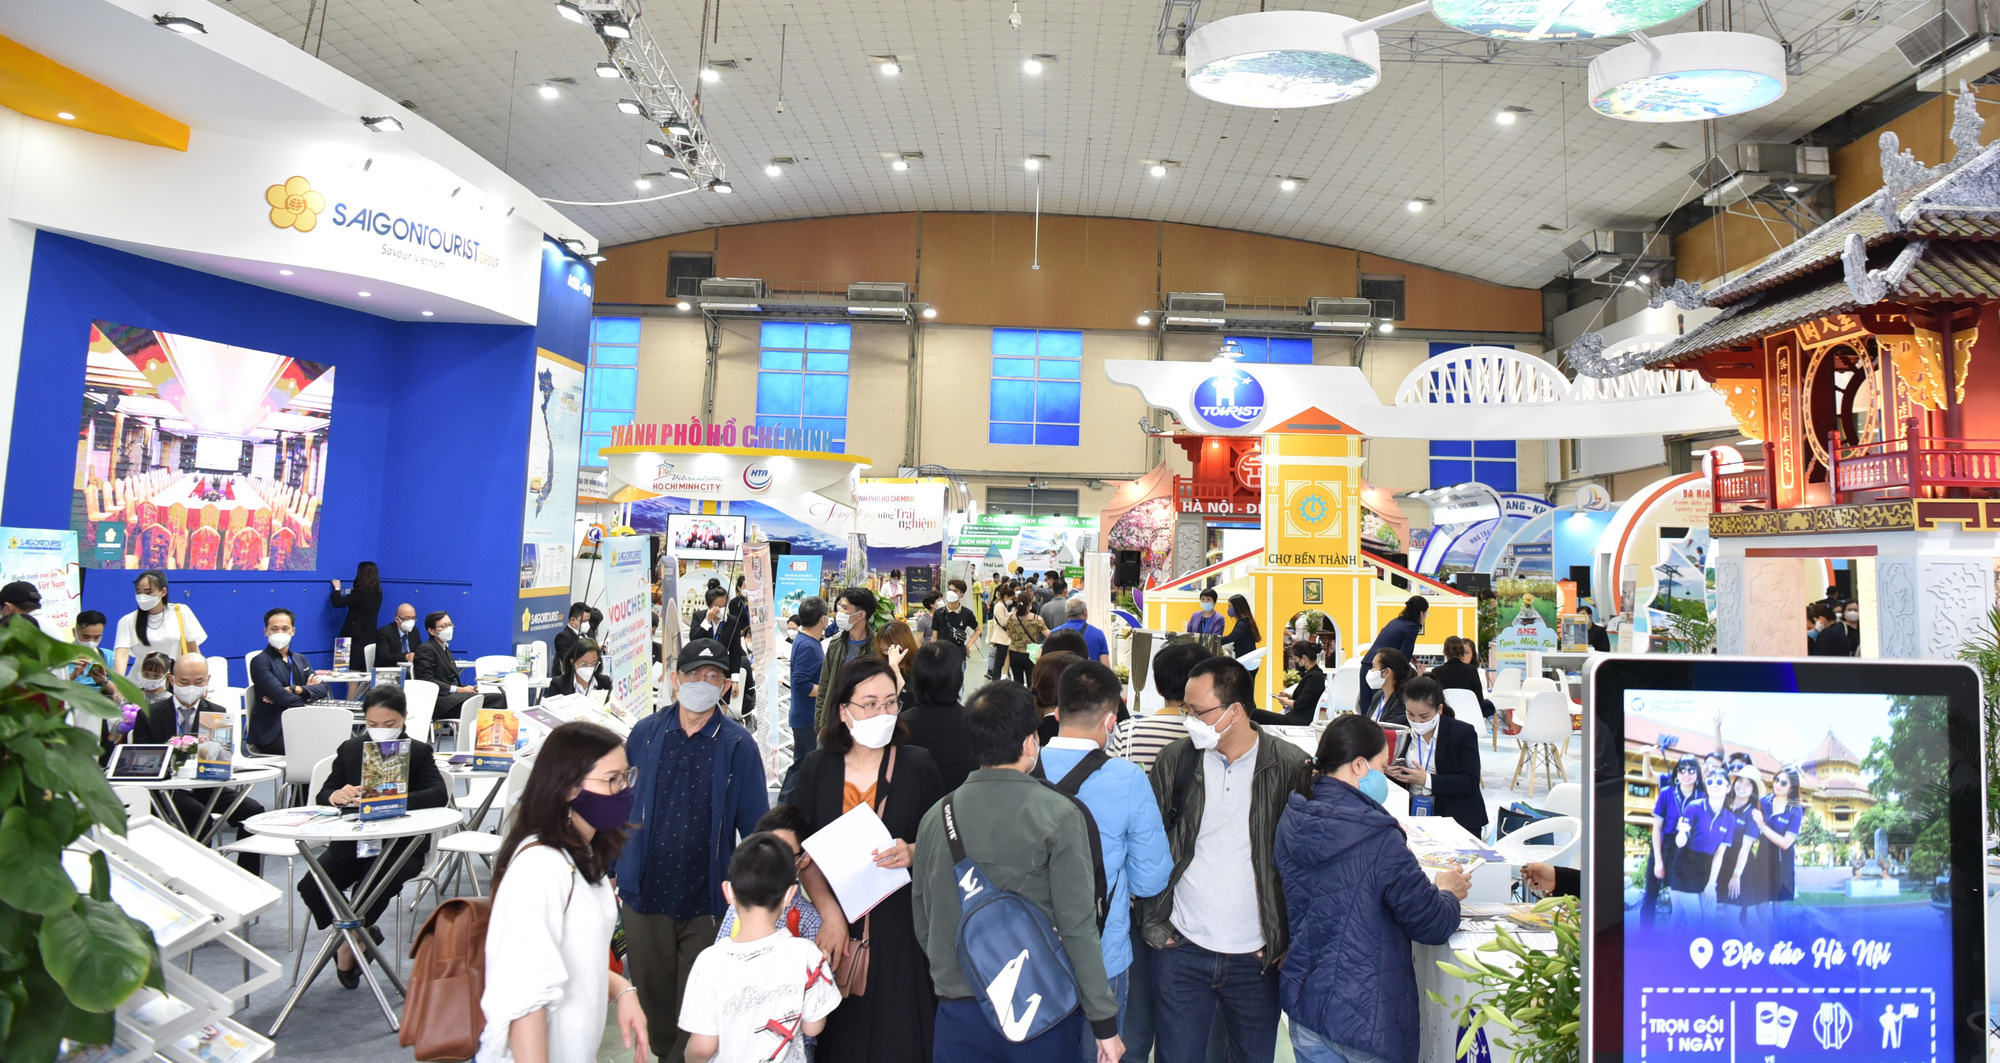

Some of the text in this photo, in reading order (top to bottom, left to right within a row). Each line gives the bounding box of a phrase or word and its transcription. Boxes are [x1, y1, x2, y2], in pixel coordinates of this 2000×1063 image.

[332, 203, 499, 269] SAIGONTOURIST GROUP
[381, 243, 446, 270] Savour Vietnam
[1200, 405, 1263, 422] TOURIST
[611, 416, 833, 453] THÀNH PHỐ HỒ CHÍ MINH
[751, 469, 769, 477] HTA
[701, 483, 721, 491] CITY
[1183, 499, 1204, 513] HÀ
[1207, 500, 1234, 517] NỘI
[1268, 551, 1357, 566] CHỢ BẾN THÀNH
[608, 592, 646, 626] VOUCHER
[944, 804, 956, 840] GIGABYTE
[1722, 939, 1764, 970] Độc
[1811, 937, 1847, 970] Hà
[1852, 939, 1892, 970] Nội
[1649, 1015, 1724, 1038] TRỌN GÓI
[1667, 1036, 1725, 1052] 1 NGÀY
